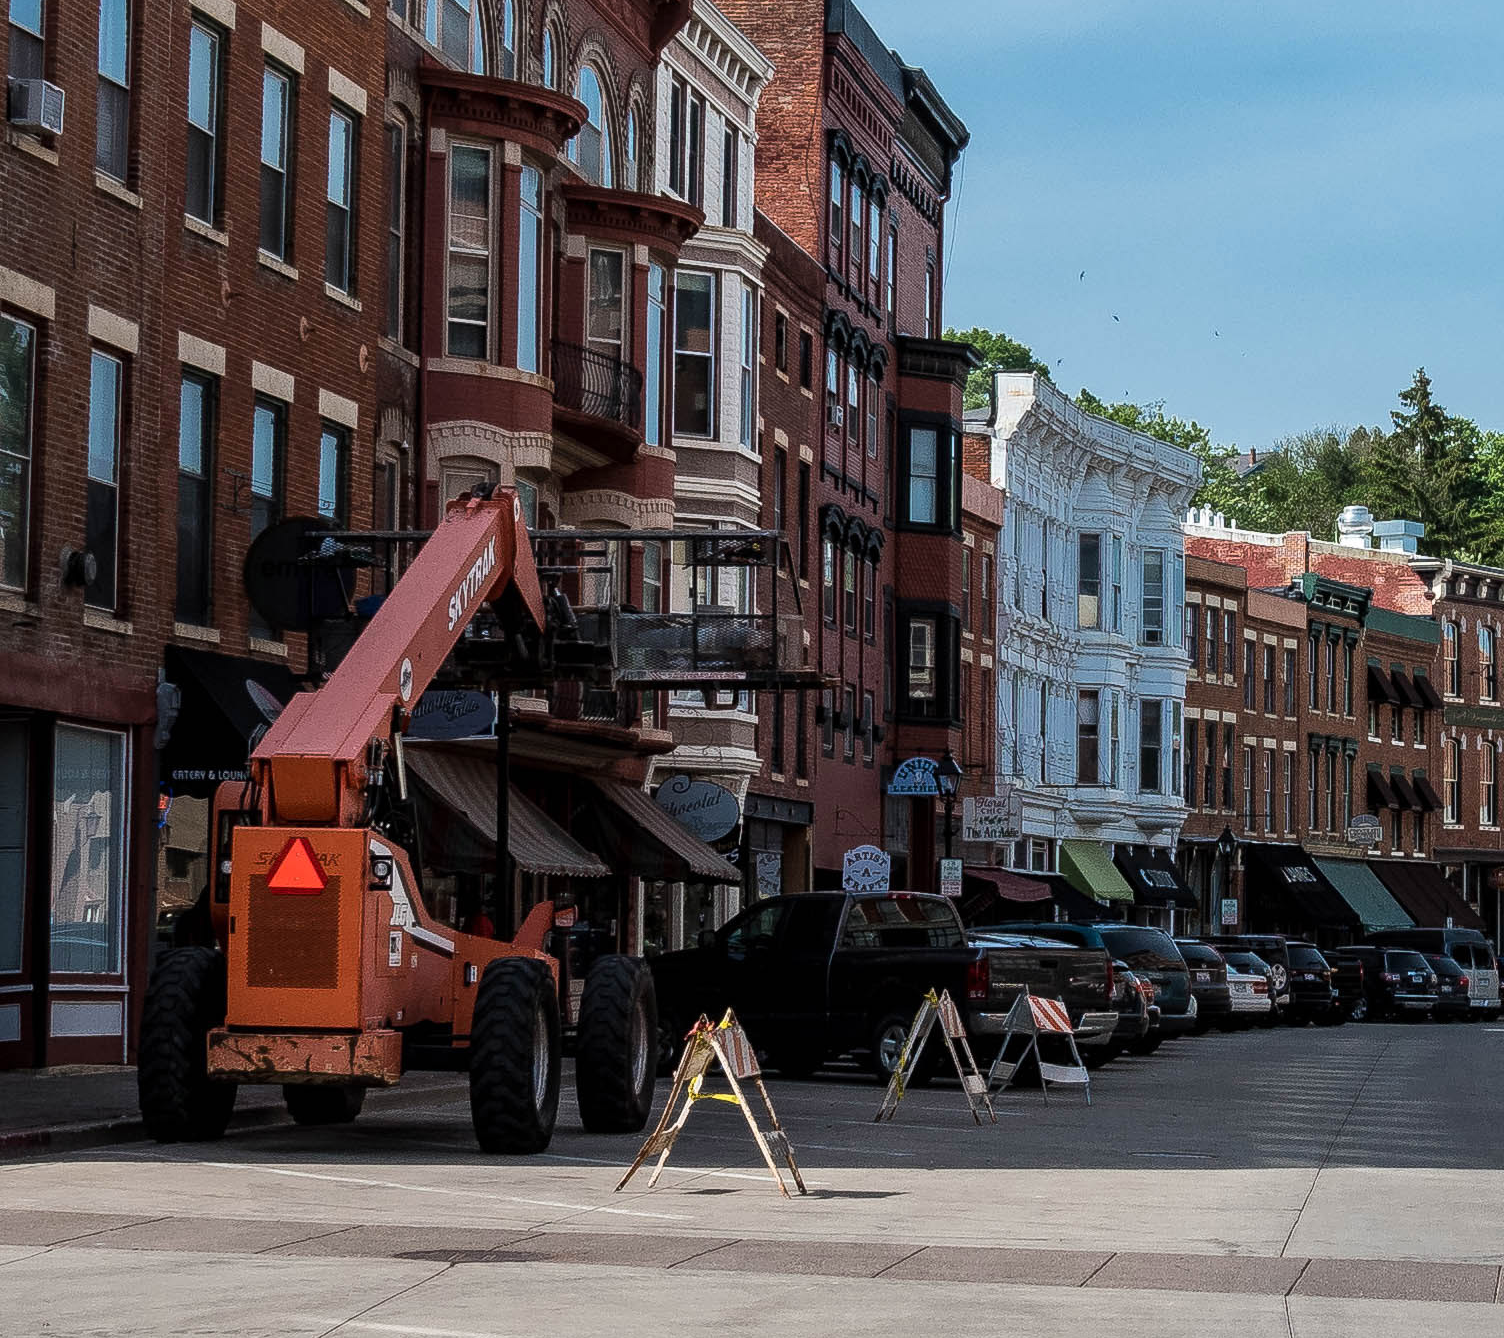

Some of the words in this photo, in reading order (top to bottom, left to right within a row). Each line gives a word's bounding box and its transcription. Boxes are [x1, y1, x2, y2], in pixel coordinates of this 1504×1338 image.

[448, 536, 496, 631] SKYTRAK
[208, 771, 216, 780] &
[218, 771, 250, 780] LOUN
[846, 851, 887, 867] ARTIST
[861, 867, 871, 877] A
